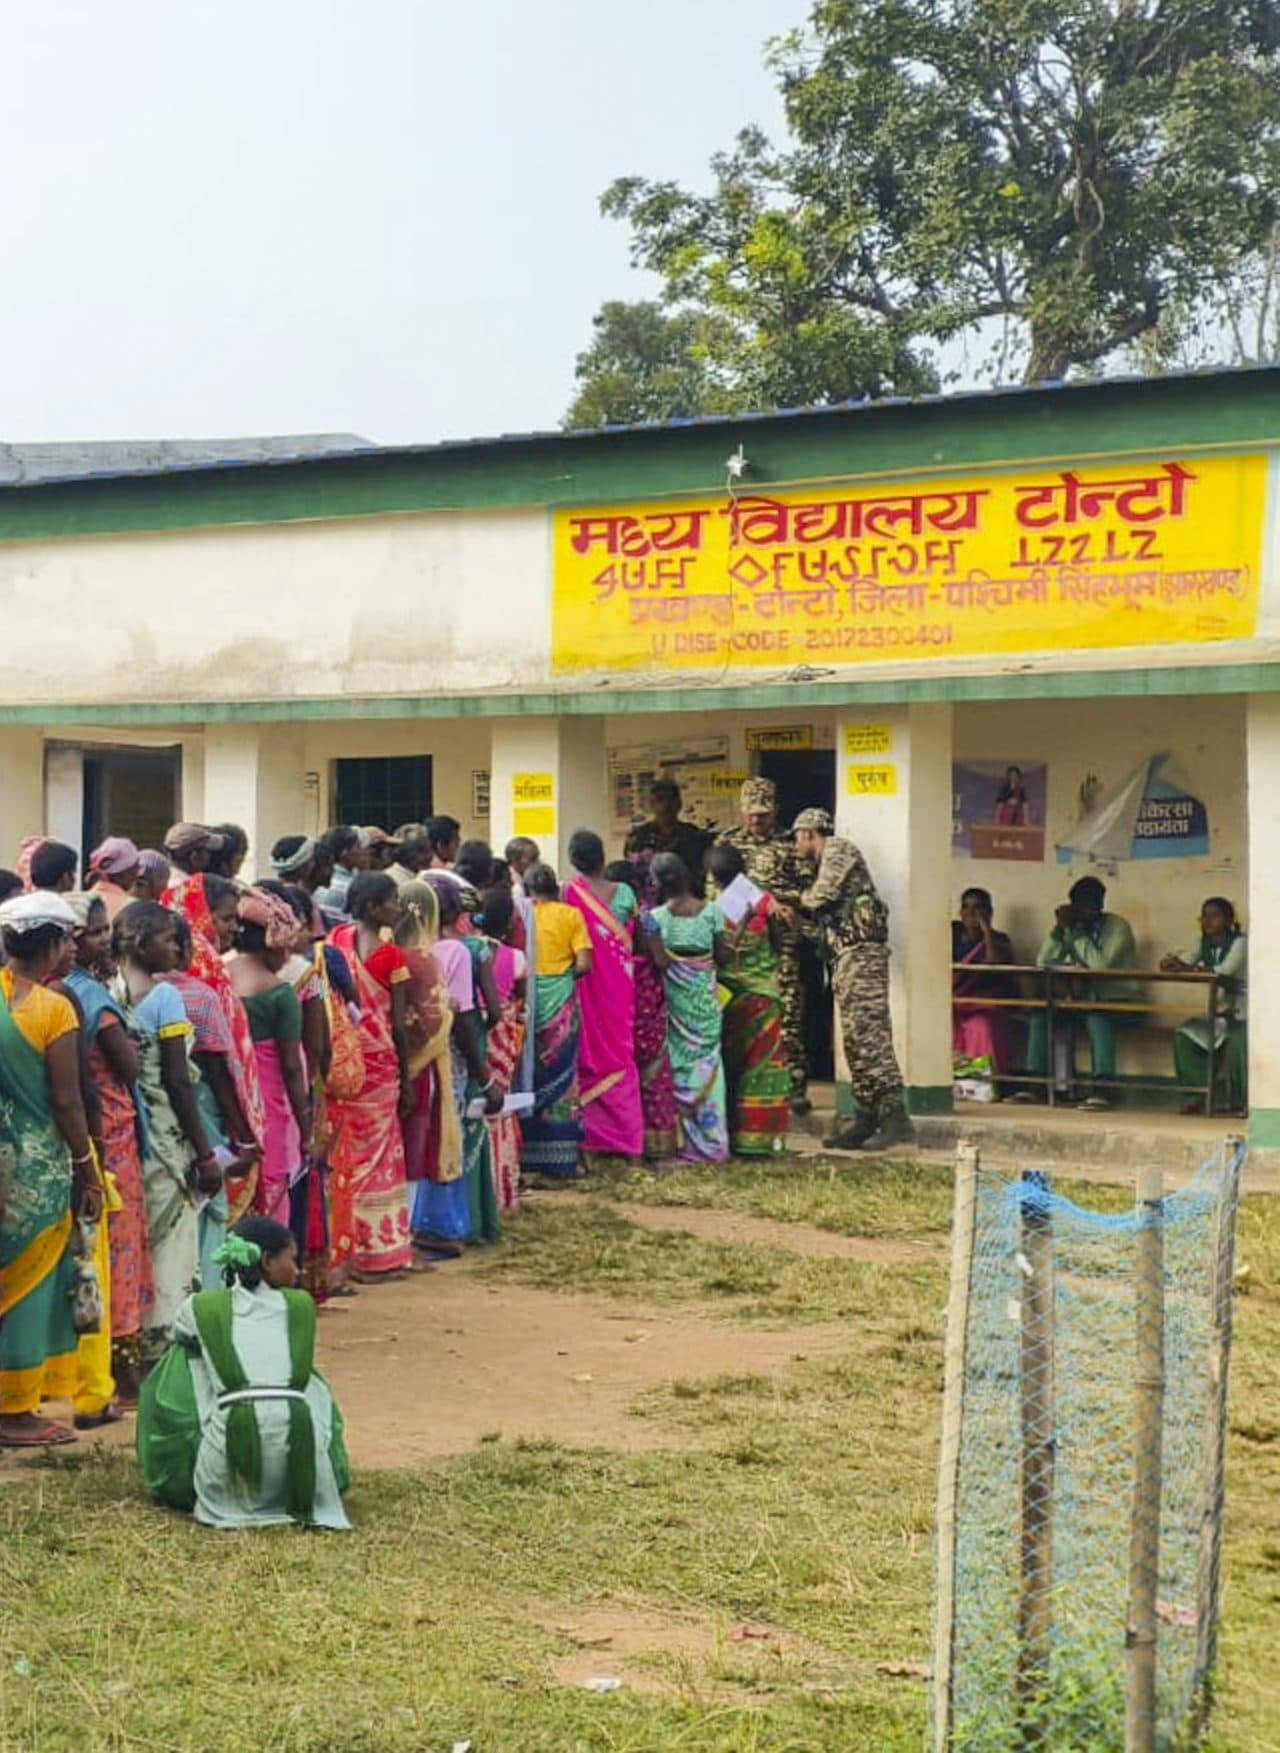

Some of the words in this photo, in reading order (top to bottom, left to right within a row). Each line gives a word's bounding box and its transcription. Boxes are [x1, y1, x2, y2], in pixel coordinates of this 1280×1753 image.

[570, 510, 711, 557] मध्य
[720, 489, 991, 546] विद्यालय
[1014, 462, 1198, 527] टोन्टो
